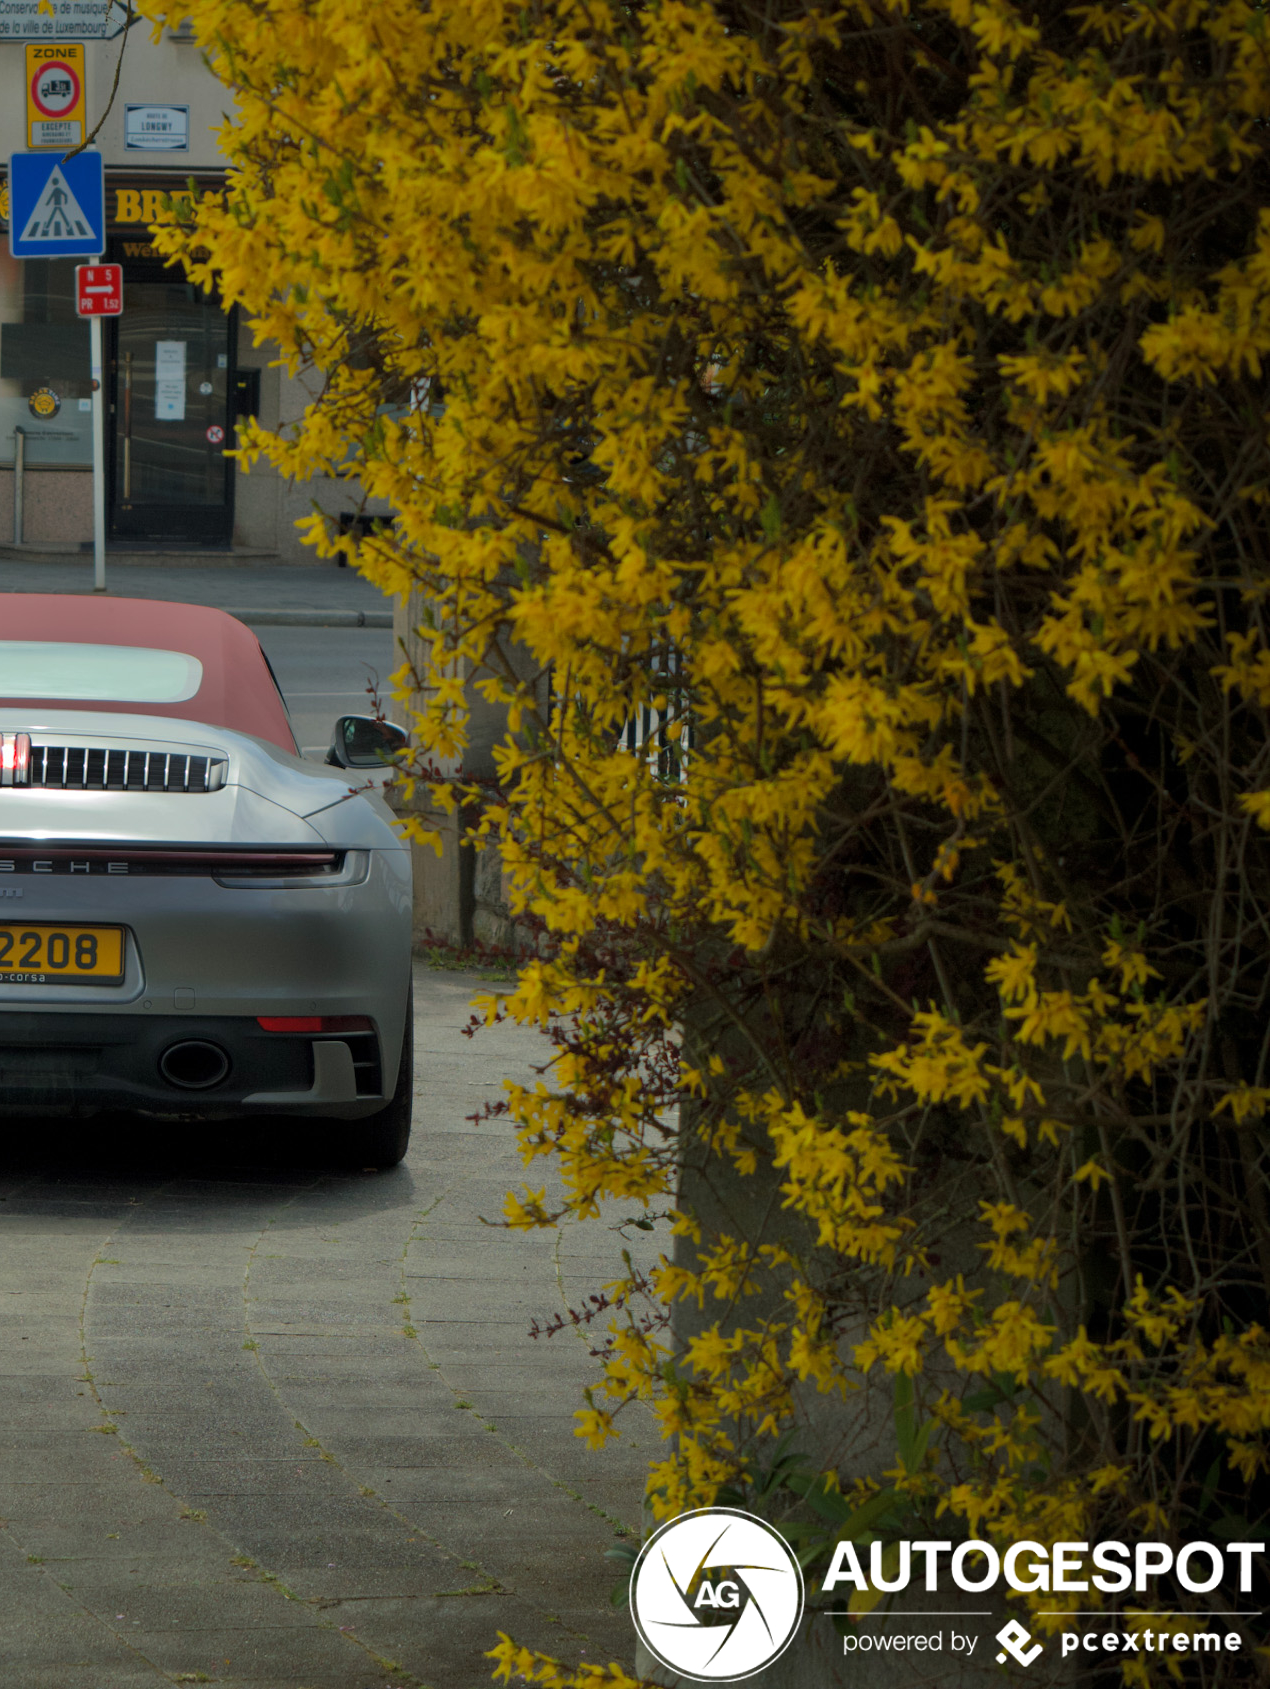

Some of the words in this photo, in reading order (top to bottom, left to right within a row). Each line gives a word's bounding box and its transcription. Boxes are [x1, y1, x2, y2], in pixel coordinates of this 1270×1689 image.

[60, 2, 71, 14] de
[73, 2, 108, 16] musique
[12, 20, 20, 34] la
[22, 20, 40, 34] ville
[42, 20, 54, 34] de
[55, 20, 107, 38] Luxembourg
[33, 48, 77, 58] ZONE
[141, 121, 173, 131] LONGWY
[87, 269, 94, 282] N
[105, 269, 112, 281] 5
[81, 298, 93, 310] PR
